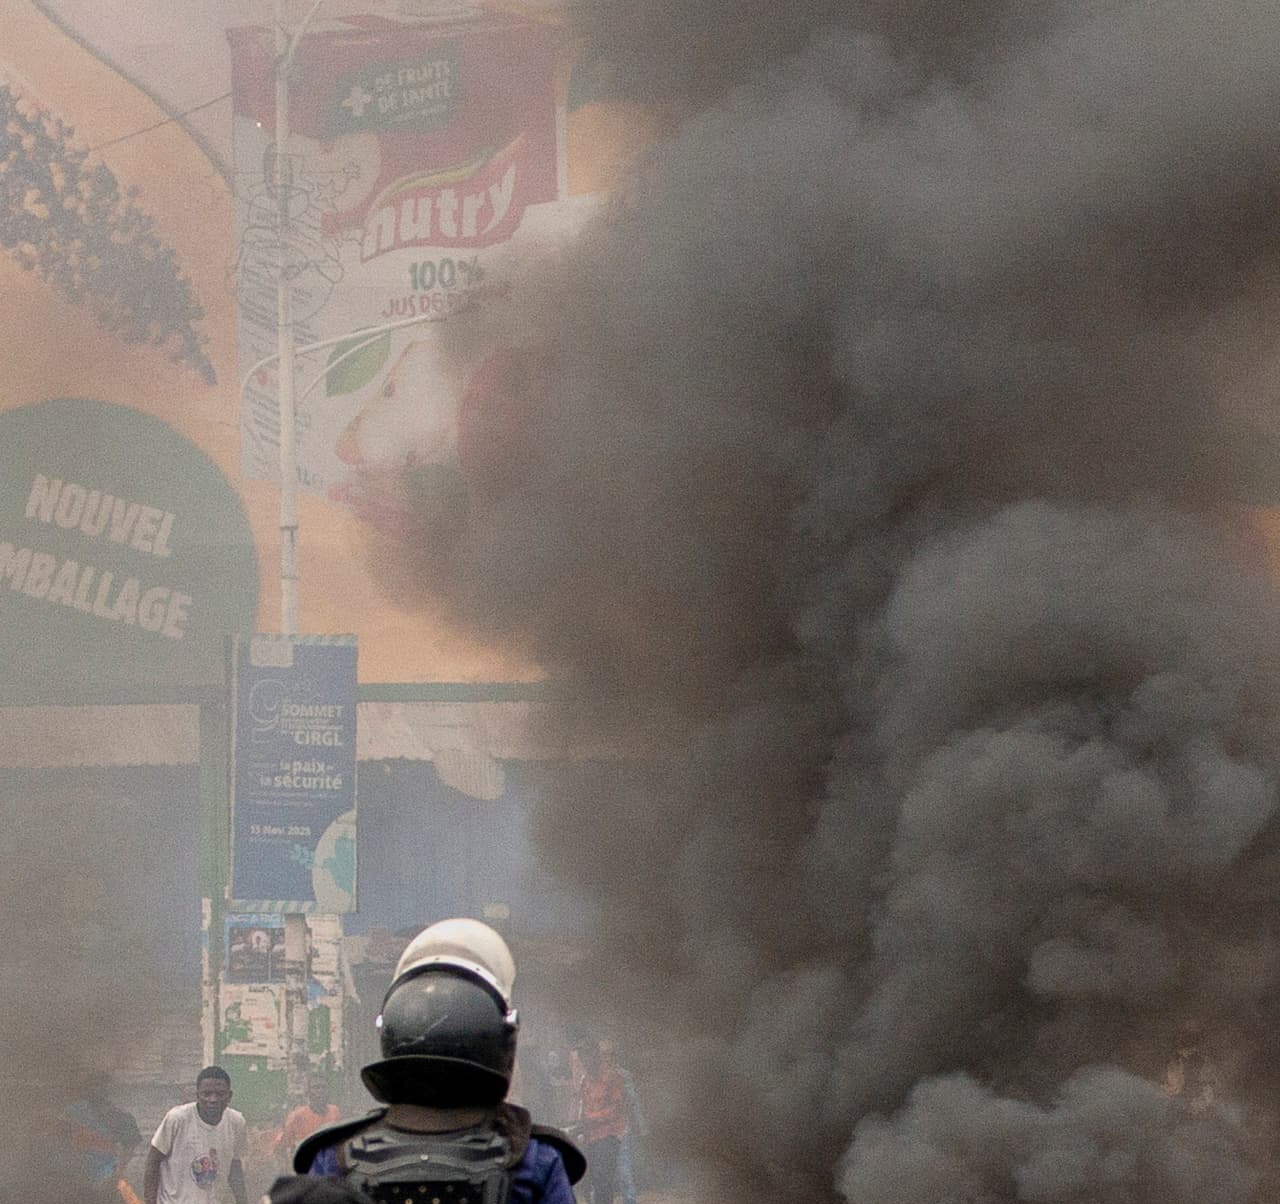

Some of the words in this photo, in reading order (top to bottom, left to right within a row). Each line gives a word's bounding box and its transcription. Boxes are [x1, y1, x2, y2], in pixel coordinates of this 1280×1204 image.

[363, 163, 517, 260] nutry
[408, 257, 485, 291] 100%
[382, 295, 416, 318] JUS
[25, 473, 176, 558] NOUVEL
[281, 704, 345, 718] SOMMET
[294, 731, 344, 747] CIRGL
[292, 758, 326, 776] paix
[274, 772, 343, 790] sécurité
